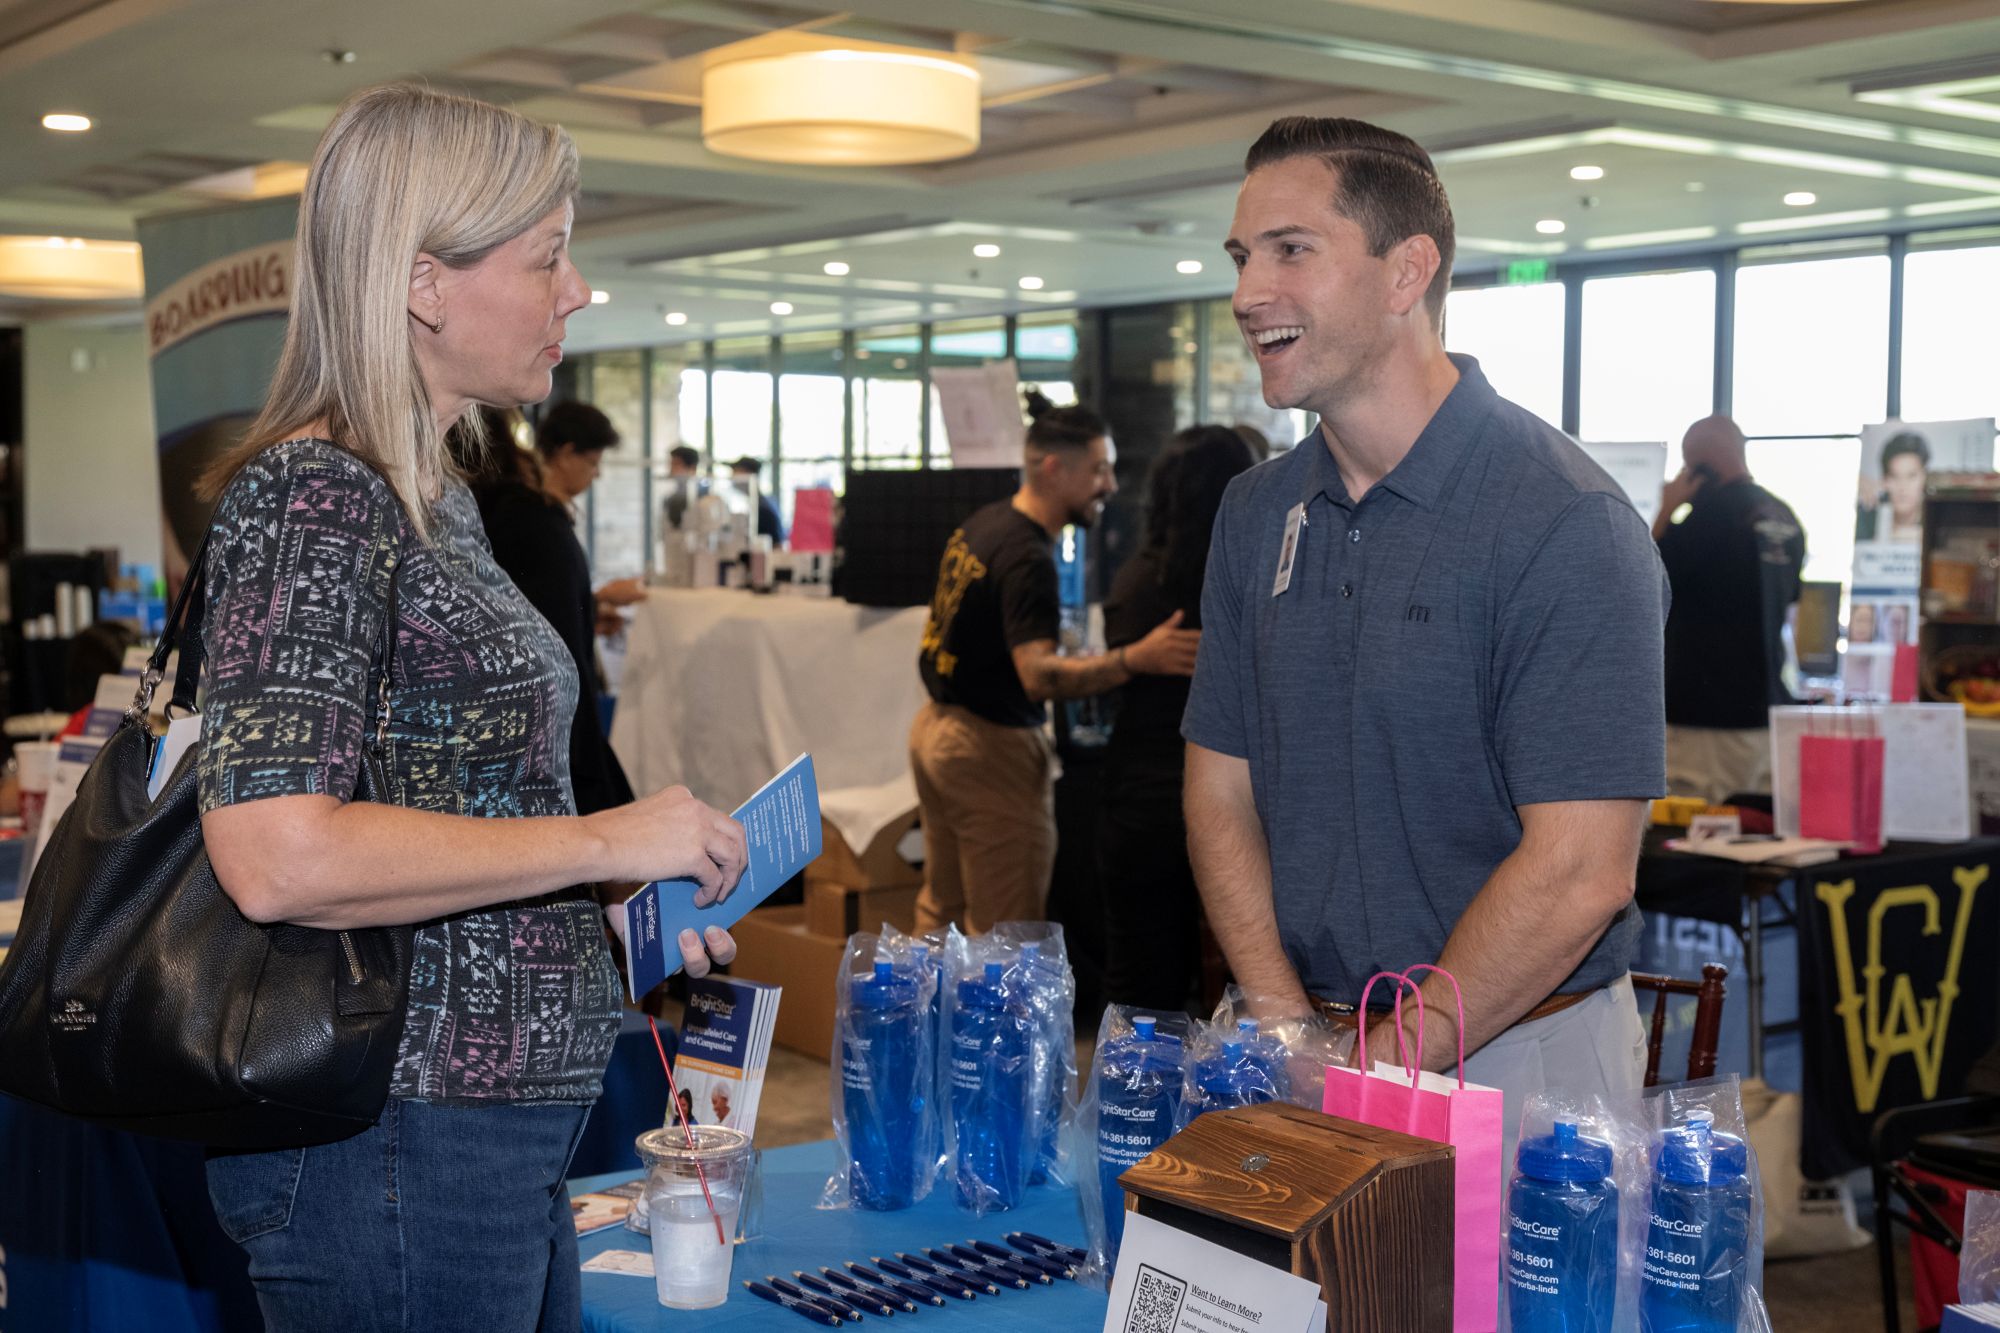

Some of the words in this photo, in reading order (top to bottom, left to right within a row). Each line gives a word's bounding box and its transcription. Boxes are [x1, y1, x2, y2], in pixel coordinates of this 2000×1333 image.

[646, 893, 656, 941] BrightStar
[690, 993, 735, 1015] BrightStar
[685, 1034, 697, 1046] and
[696, 1036, 733, 1053] Compassion
[722, 1031, 738, 1043] Care
[1191, 1284, 1208, 1299] Want
[1209, 1291, 1217, 1302] to
[1217, 1296, 1237, 1311] Learn
[1238, 1304, 1263, 1321] More?
[1180, 1319, 1197, 1332] Submit
[1185, 1304, 1201, 1315] Submit
[1201, 1310, 1213, 1321] your
[1212, 1315, 1223, 1325] info
[1222, 1319, 1229, 1328] to
[1228, 1321, 1241, 1332] hear
